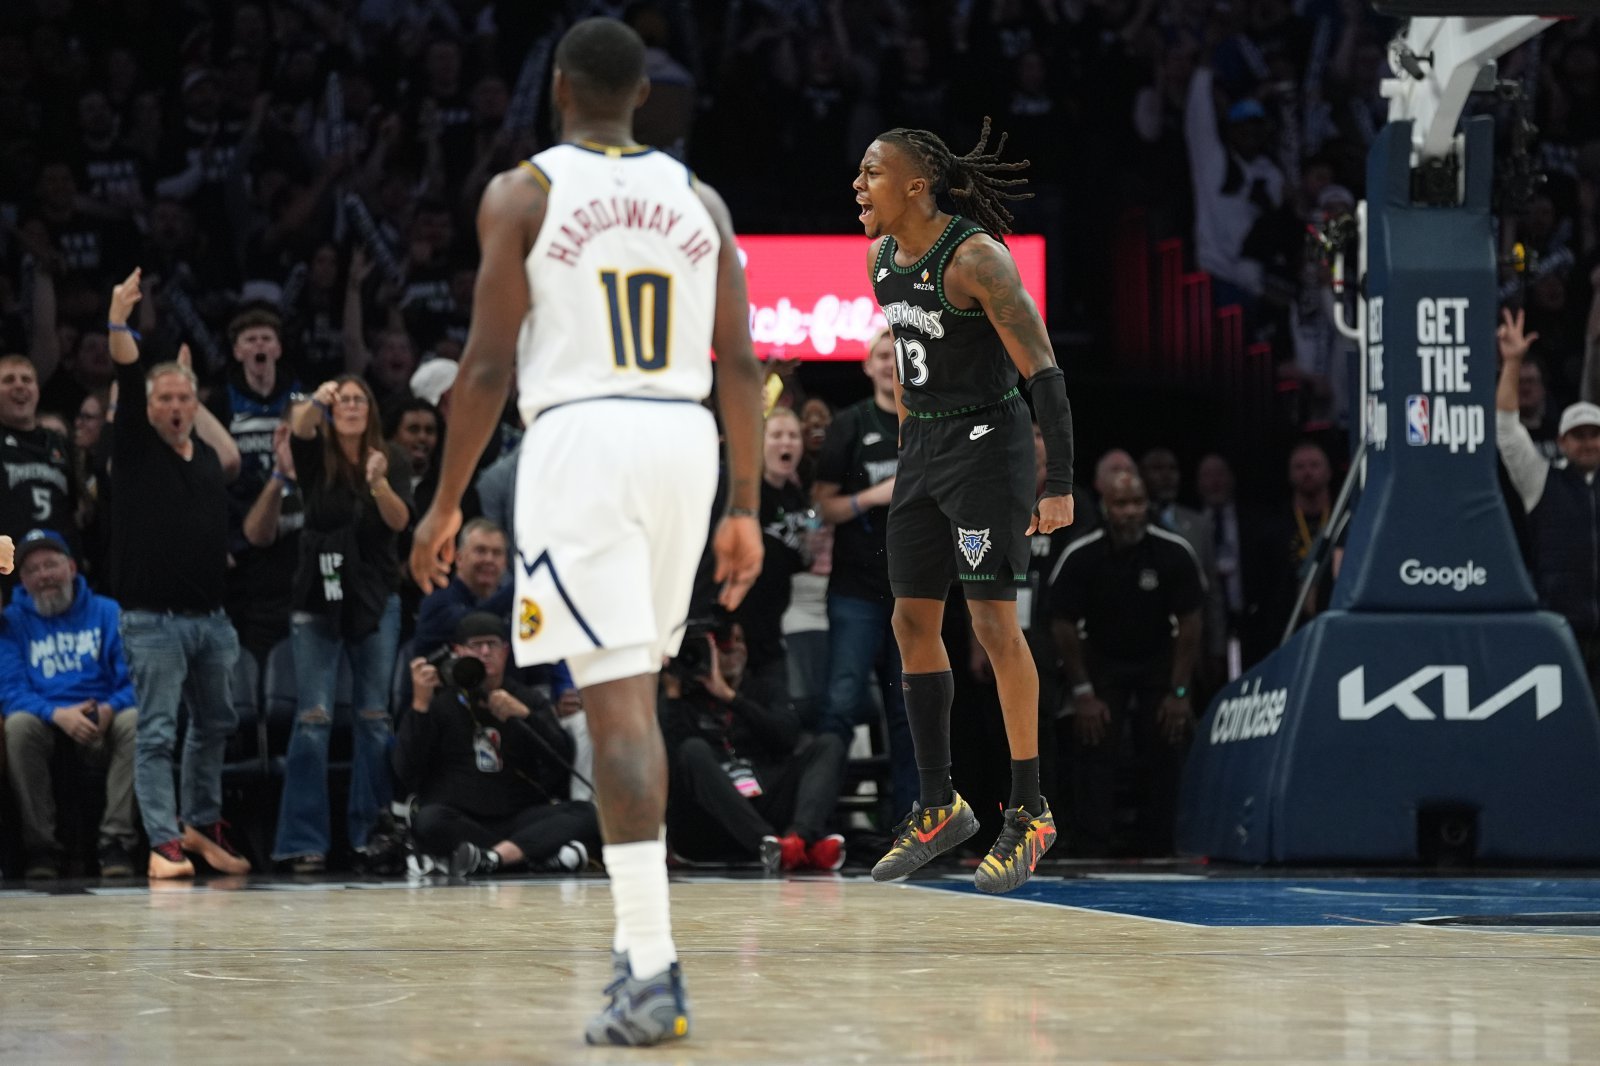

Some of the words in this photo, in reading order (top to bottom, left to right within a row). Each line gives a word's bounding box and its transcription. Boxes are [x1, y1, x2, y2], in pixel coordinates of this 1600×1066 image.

[913, 282, 935, 291] sezzle
[598, 268, 673, 373] 10
[1416, 297, 1470, 345] GET
[894, 337, 929, 386] 13
[1416, 345, 1472, 393] THE
[1431, 395, 1486, 454] App
[31, 486, 52, 521] 5
[1400, 558, 1487, 591] Google
[1210, 676, 1288, 746] coinbase
[1338, 664, 1563, 721] KIA
